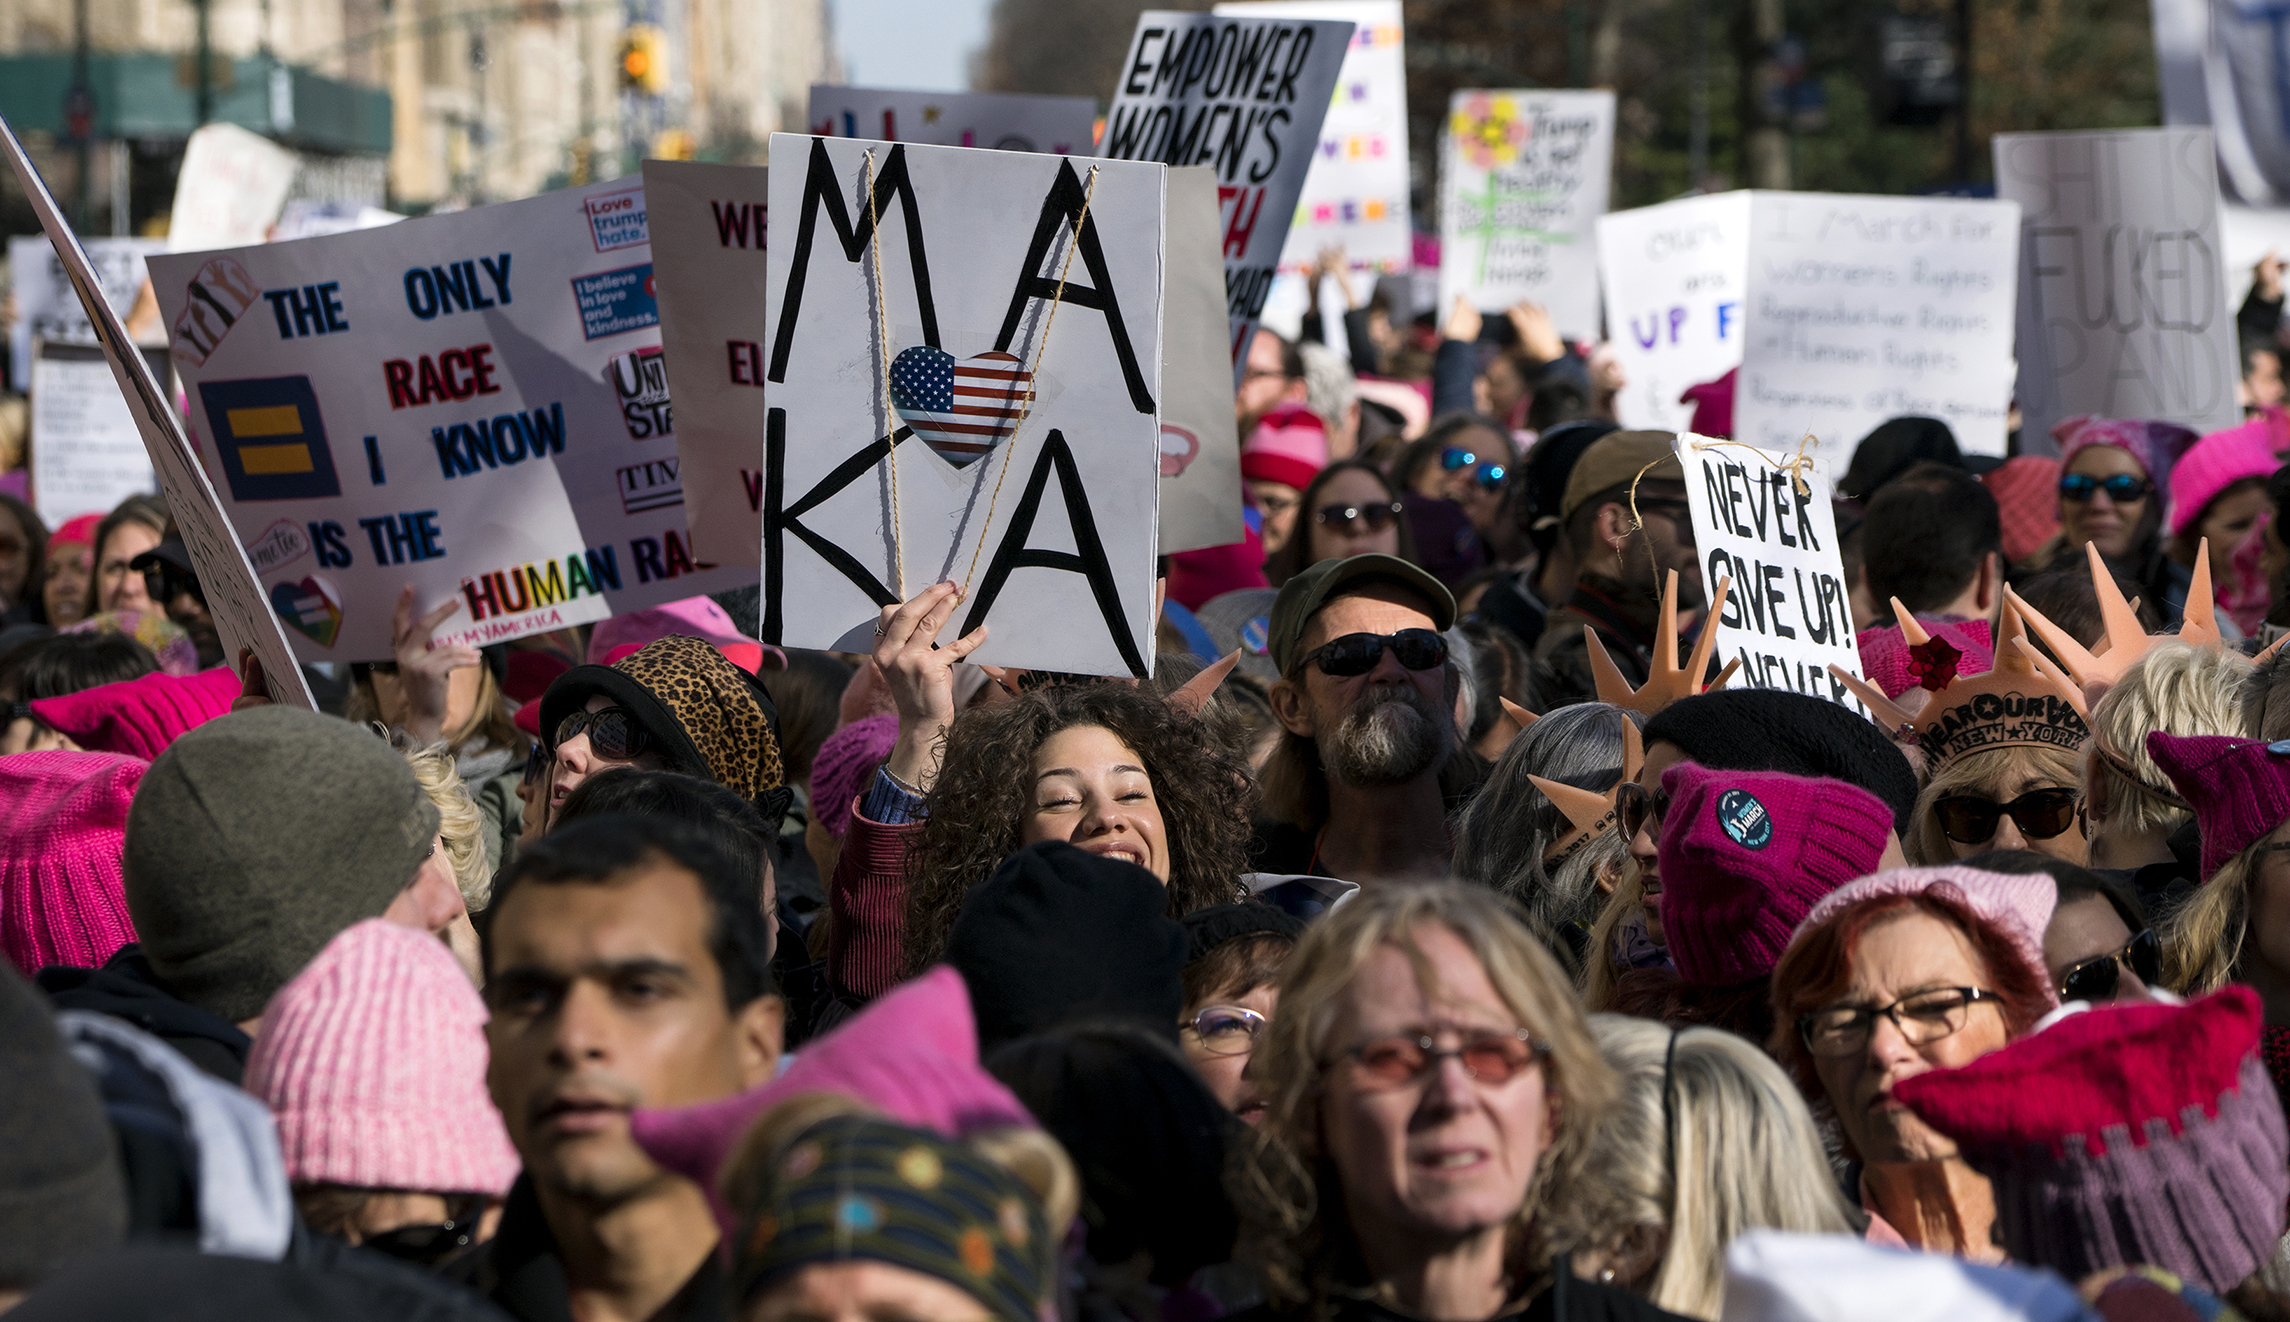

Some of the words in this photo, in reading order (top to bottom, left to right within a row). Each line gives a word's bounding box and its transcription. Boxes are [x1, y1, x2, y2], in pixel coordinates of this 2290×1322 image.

[1126, 22, 1315, 103] EMPOWER
[1108, 103, 1291, 184] WOMEN'S
[590, 196, 633, 215] Love
[597, 227, 646, 247] hate.
[263, 281, 349, 340] THE
[403, 253, 512, 321] ONLY
[580, 294, 595, 309] in
[595, 289, 627, 306] love
[584, 272, 638, 293] believe
[2026, 223, 2216, 335] FUCKED
[584, 303, 613, 321] and
[587, 311, 657, 337] kindness.
[1631, 307, 1688, 349] UP
[383, 343, 501, 411] RACE
[364, 435, 386, 487] I
[432, 402, 566, 480] KNOW
[1703, 458, 1821, 552] NEVER
[307, 518, 354, 569] IS
[358, 509, 446, 567] THE
[462, 545, 622, 622] HUMAN
[1794, 566, 1851, 650] UP!
[1973, 692, 2046, 721] OUR
[1948, 724, 2004, 757] NEW
[2020, 721, 2083, 750] YORK
[1741, 803, 1765, 829] MARCH
[1565, 832, 1591, 852] 2017
